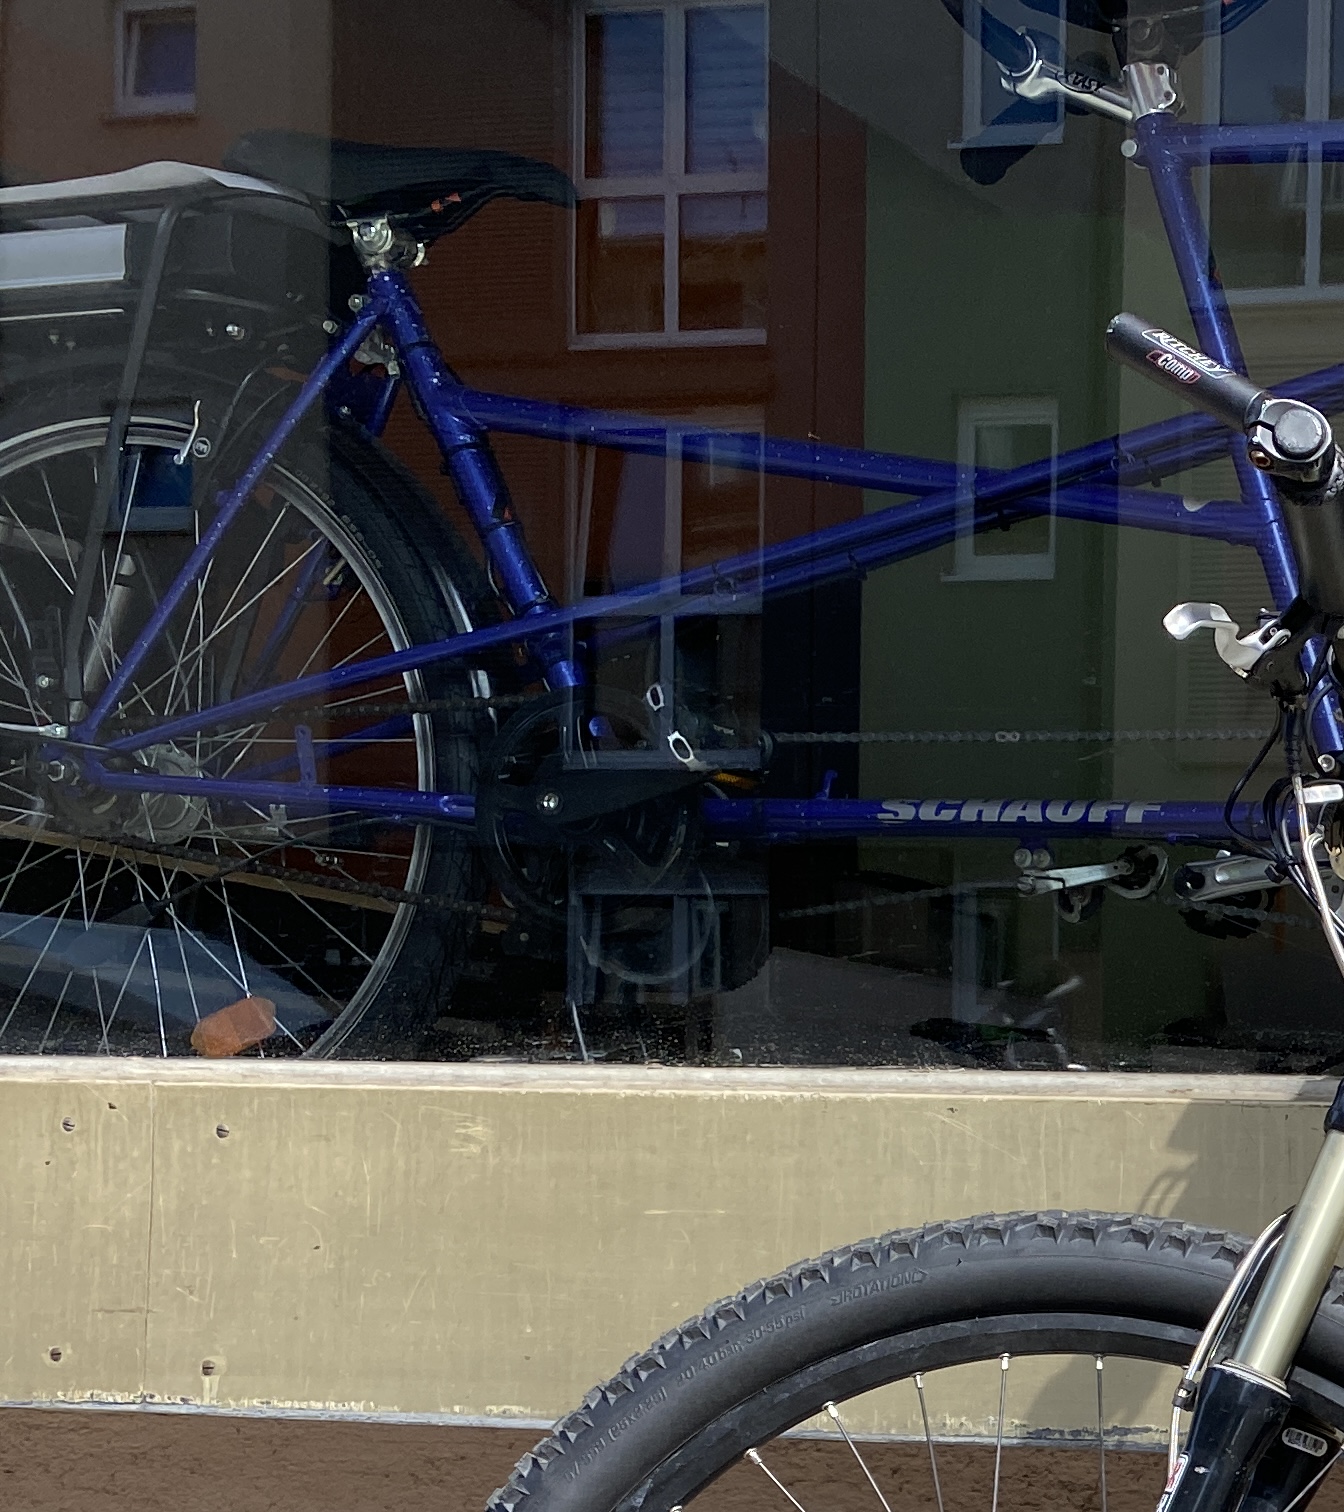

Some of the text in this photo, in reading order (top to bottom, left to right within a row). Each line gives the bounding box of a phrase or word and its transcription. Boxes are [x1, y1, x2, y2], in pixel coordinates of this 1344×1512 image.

[1152, 331, 1228, 372] RITCHEY
[1157, 353, 1194, 380] Comp
[877, 799, 1160, 824] SCHAUFF
